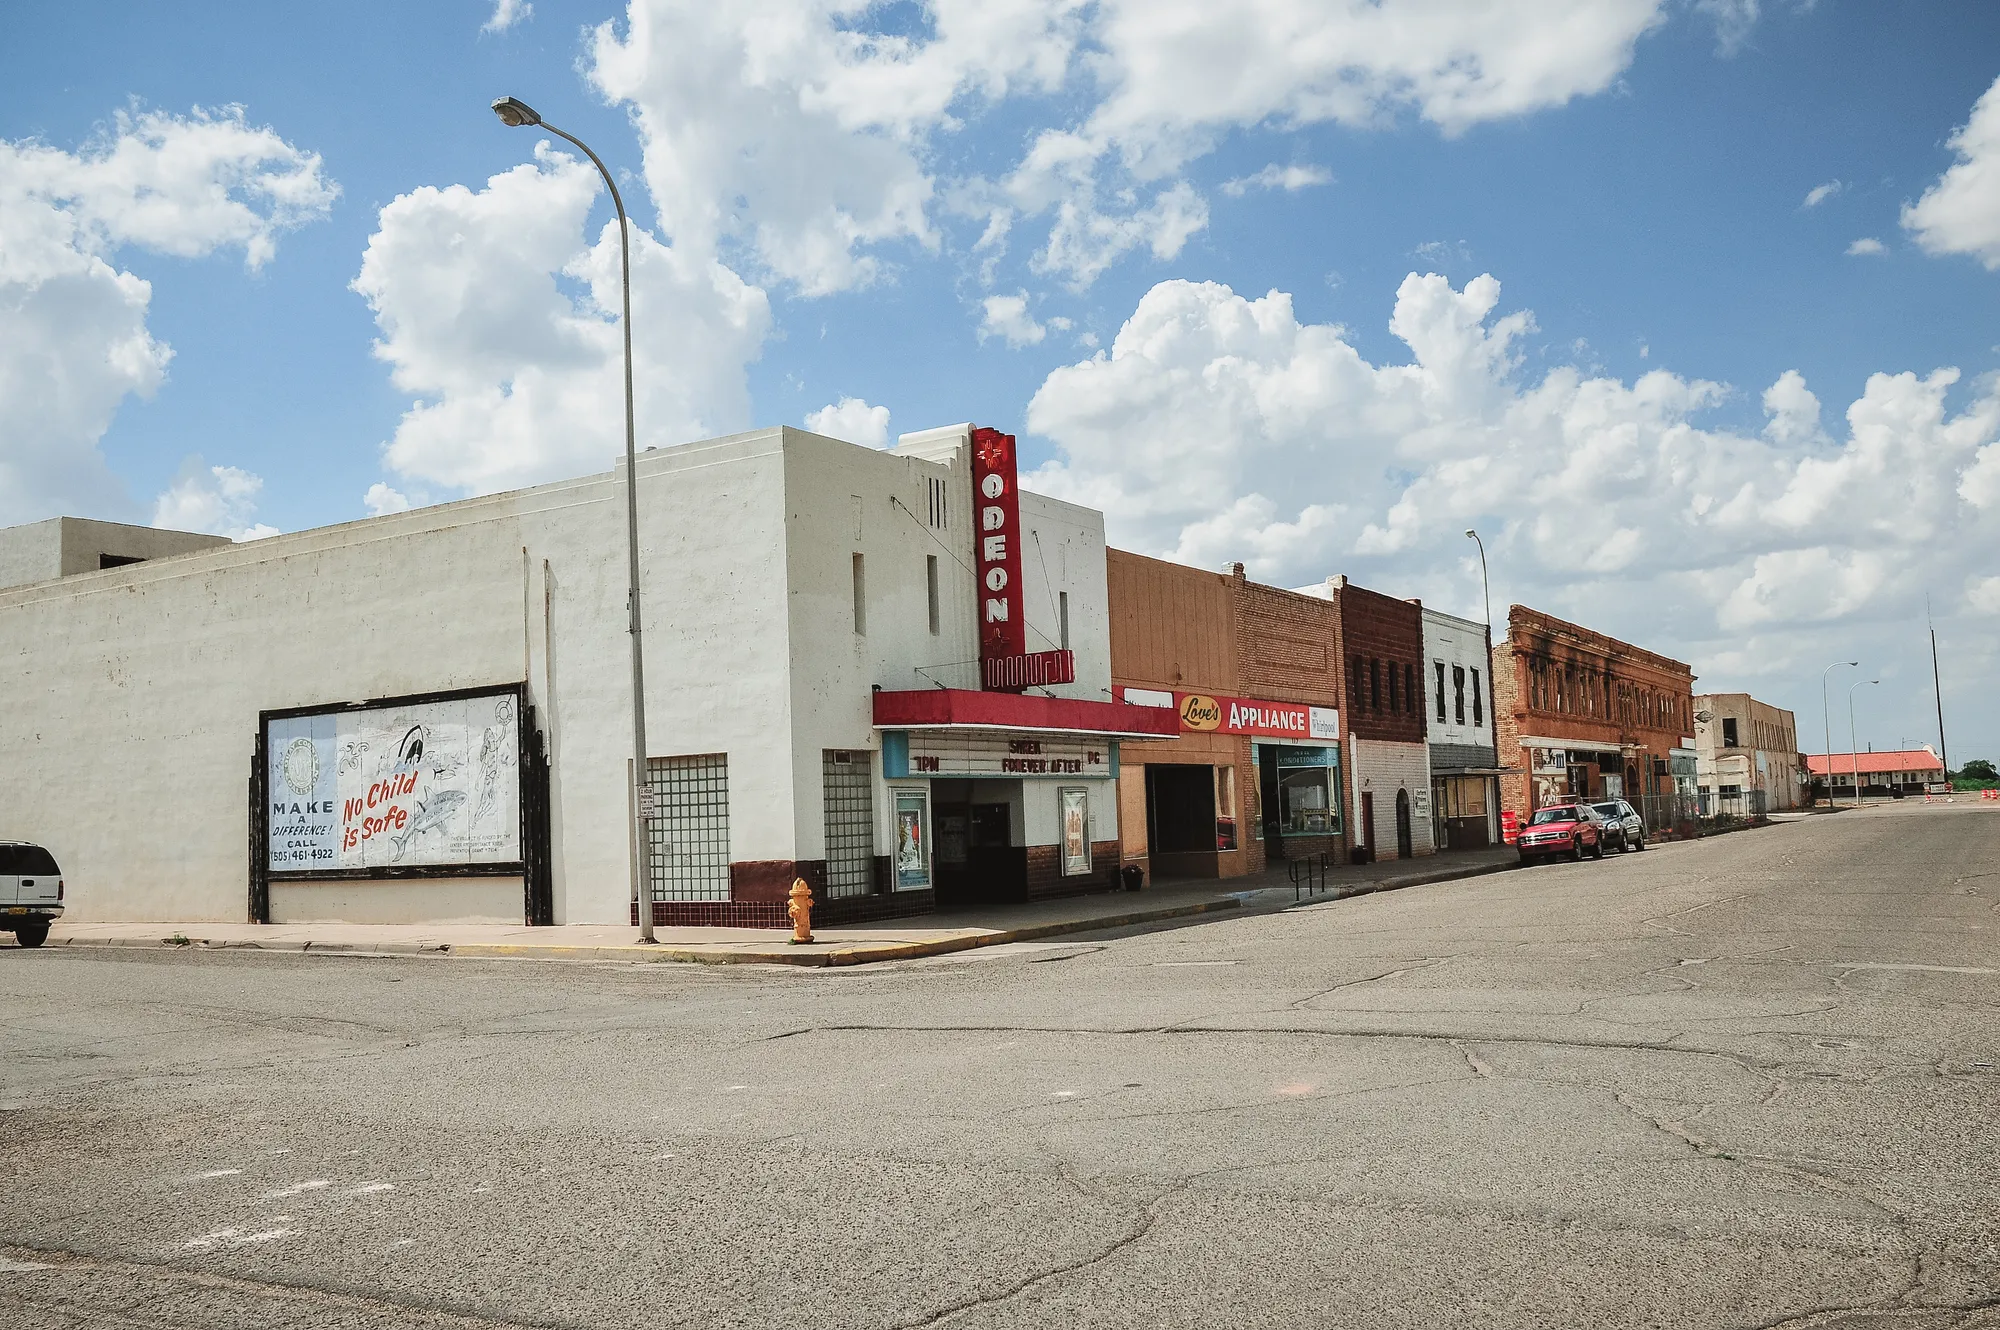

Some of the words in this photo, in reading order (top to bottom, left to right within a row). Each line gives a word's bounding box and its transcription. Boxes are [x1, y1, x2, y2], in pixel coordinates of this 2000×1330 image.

[982, 473, 1009, 623] ODEON
[1182, 697, 1219, 726] Love's
[1228, 702, 1305, 731] APPLIANCE
[1311, 718, 1336, 737] Whirlpool
[1002, 757, 1047, 773] FOREVER
[1051, 758, 1082, 773] AFTER
[367, 770, 419, 809] Child
[273, 801, 333, 815] MAKE
[297, 815, 306, 824] A
[272, 824, 333, 836] DIFFERENCE!
[343, 827, 359, 852] is
[361, 805, 408, 840] Safe
[287, 839, 317, 848] CALL
